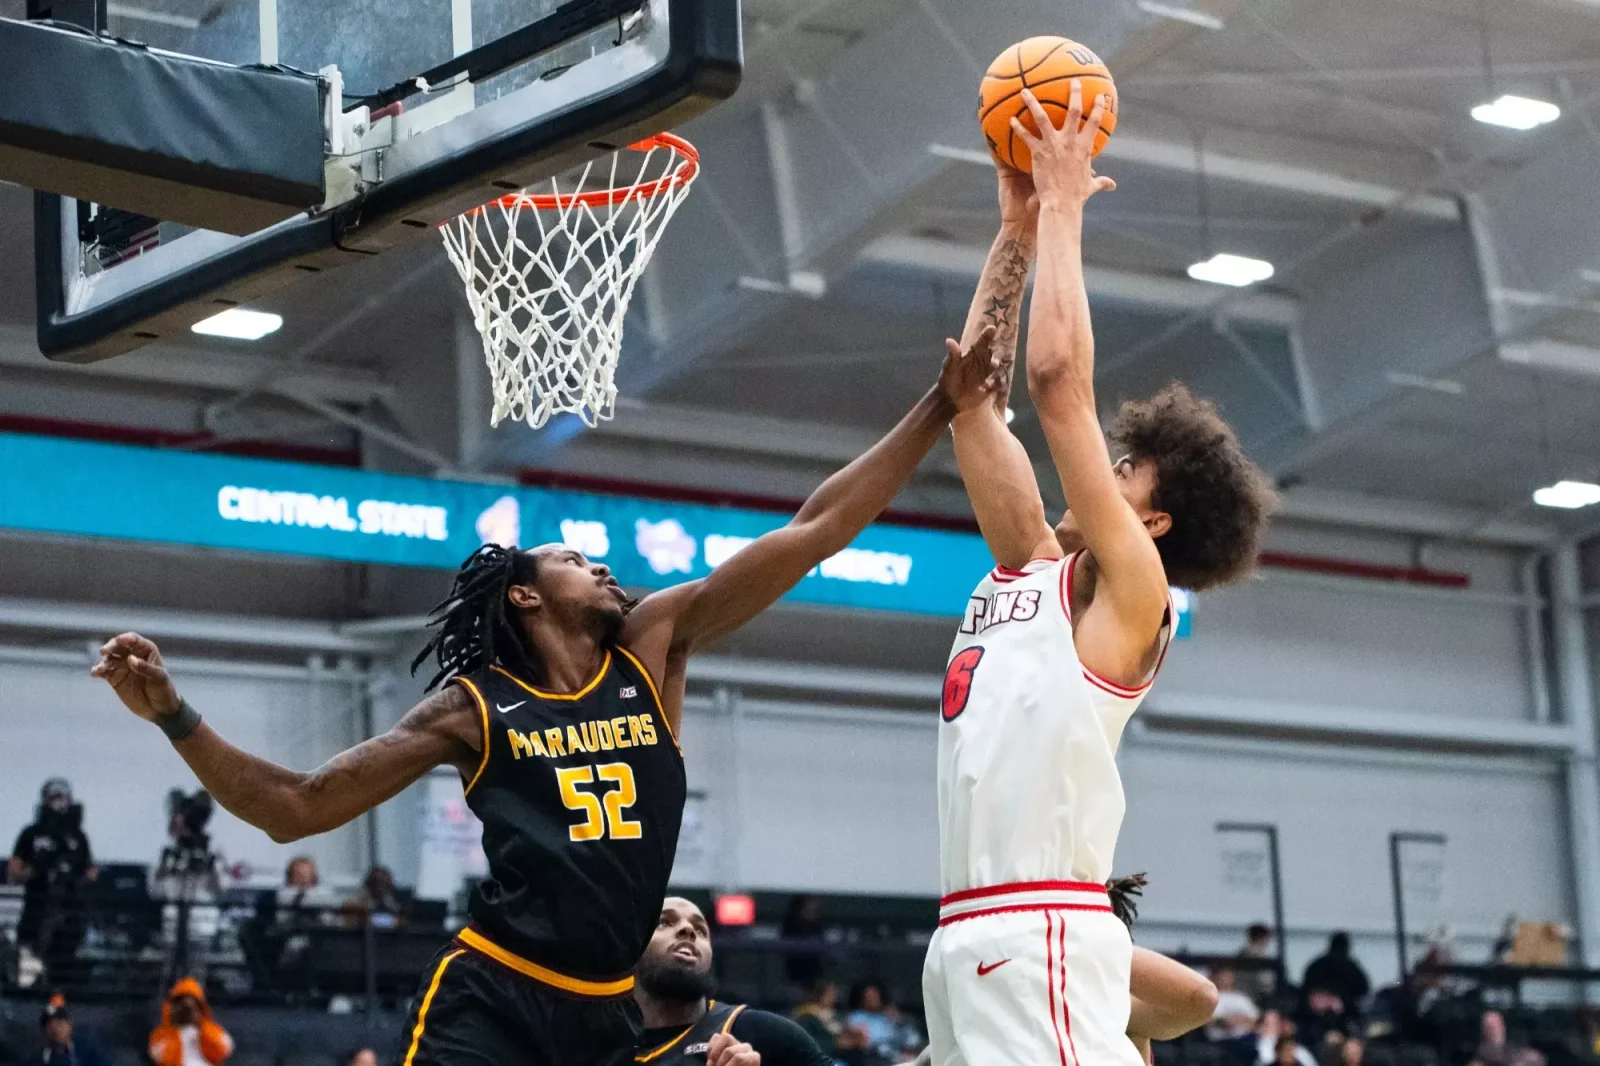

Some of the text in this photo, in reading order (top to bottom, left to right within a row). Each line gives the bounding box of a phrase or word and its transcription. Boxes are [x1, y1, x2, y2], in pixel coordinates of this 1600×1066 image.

[218, 485, 357, 531] CENTRAL
[358, 499, 448, 541] STATE
[942, 645, 985, 723] 6
[508, 713, 657, 759] MARAUDERS
[555, 762, 641, 841] 52
